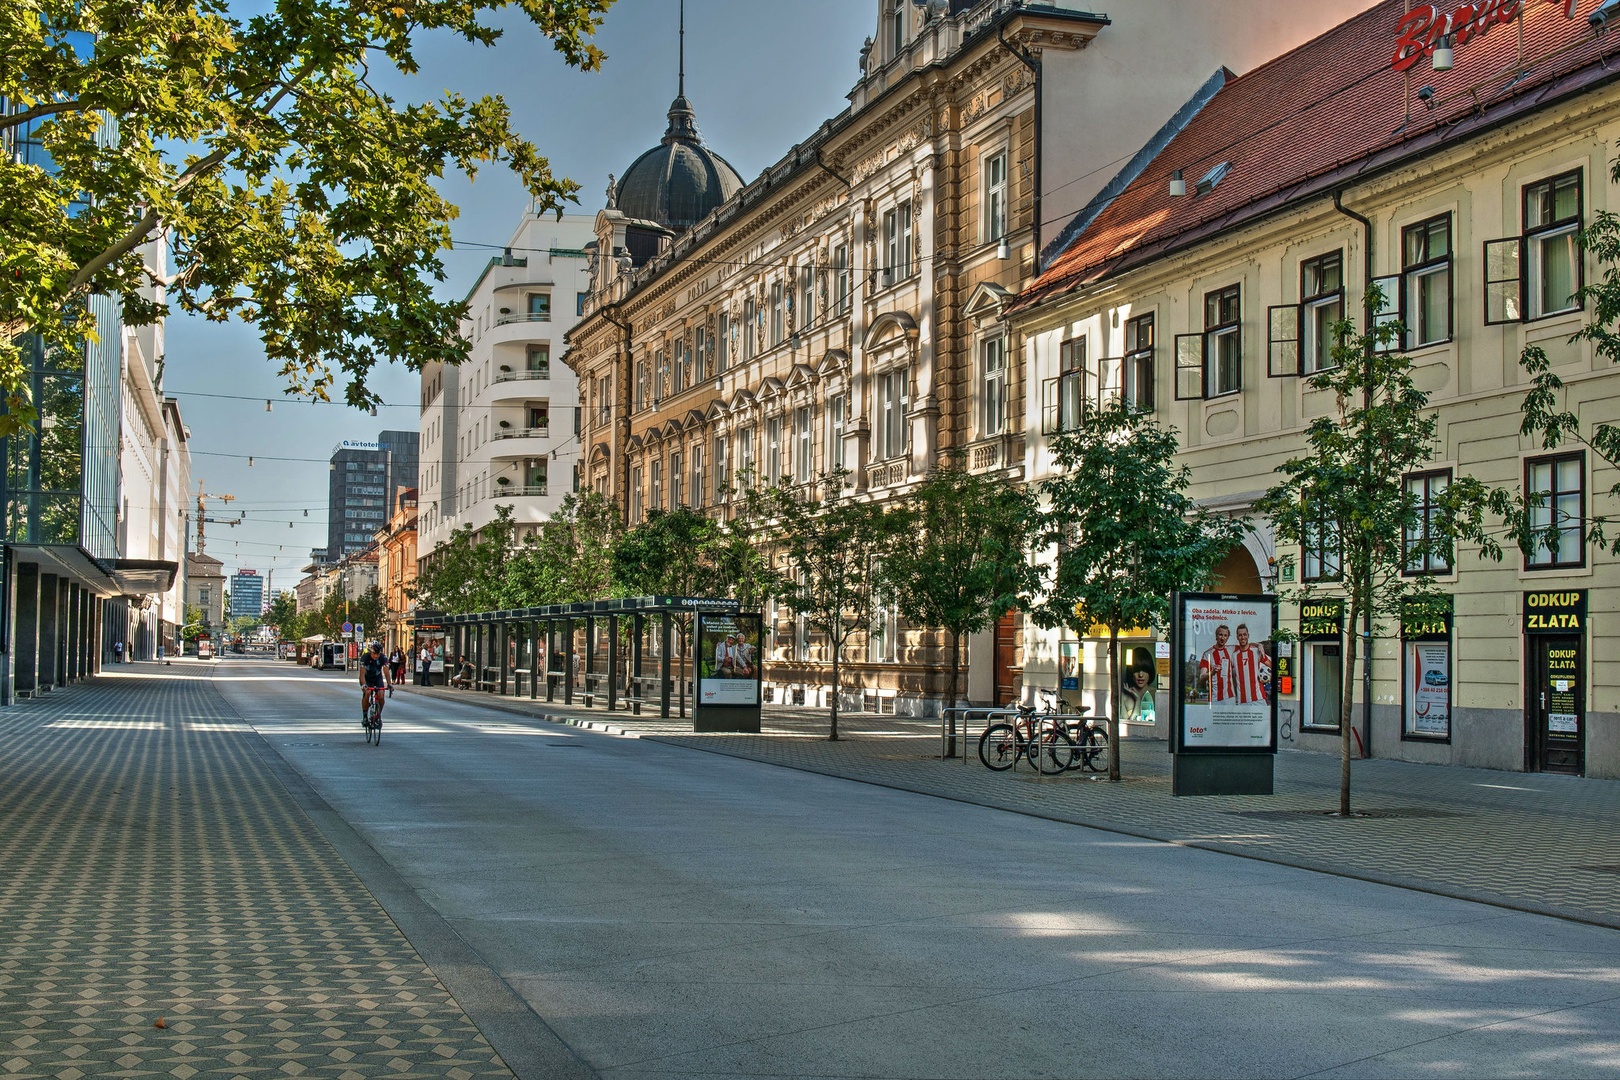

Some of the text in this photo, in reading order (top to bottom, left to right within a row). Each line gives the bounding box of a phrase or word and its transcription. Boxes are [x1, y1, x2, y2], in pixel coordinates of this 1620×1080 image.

[687, 241, 765, 302] POŠTA SLOVENIJE
[1528, 593, 1580, 607] ODKUP
[1528, 614, 1580, 628] ZLATA
[1550, 650, 1576, 658] ODKUP
[1550, 660, 1576, 668] ZLATA
